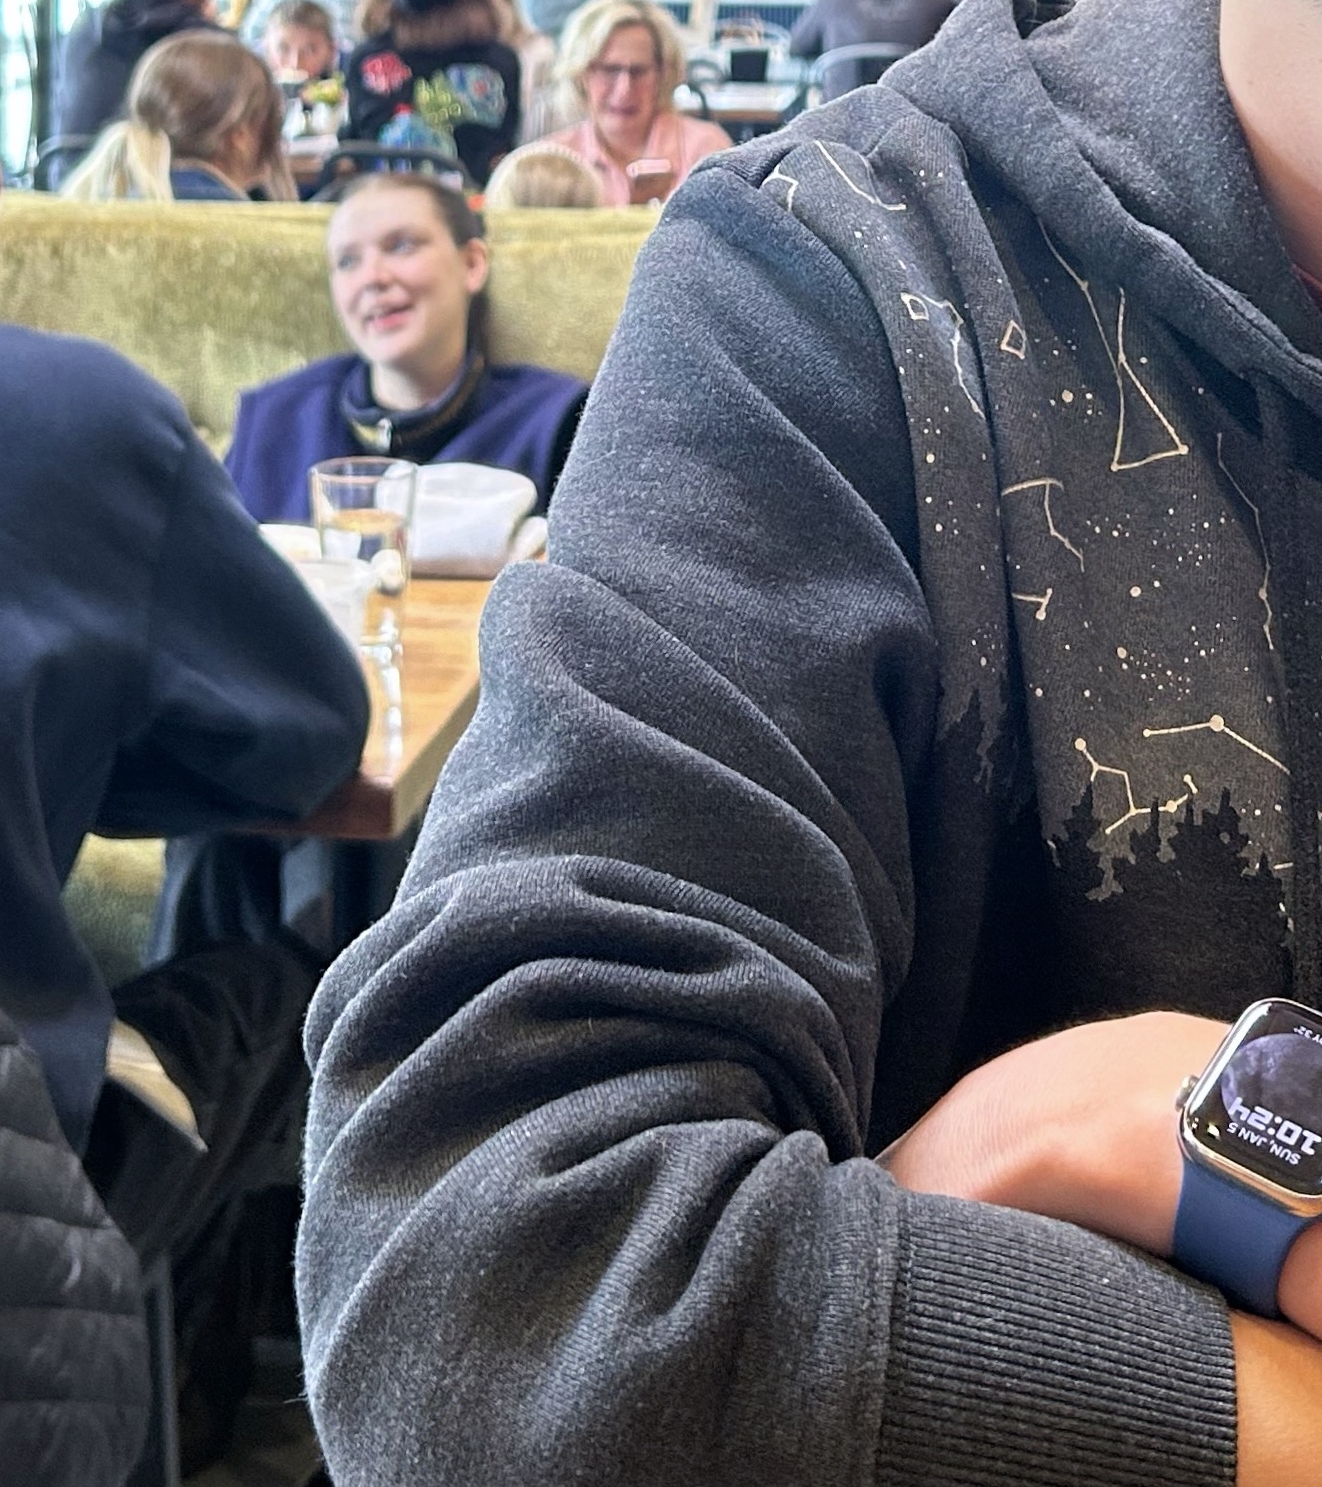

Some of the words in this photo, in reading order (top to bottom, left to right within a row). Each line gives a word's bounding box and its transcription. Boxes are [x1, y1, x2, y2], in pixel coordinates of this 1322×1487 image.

[1227, 1122, 1239, 1134] 5
[1228, 1096, 1322, 1156] 10:24
[1238, 1127, 1268, 1147] JAN
[1269, 1139, 1302, 1165] SUN,
